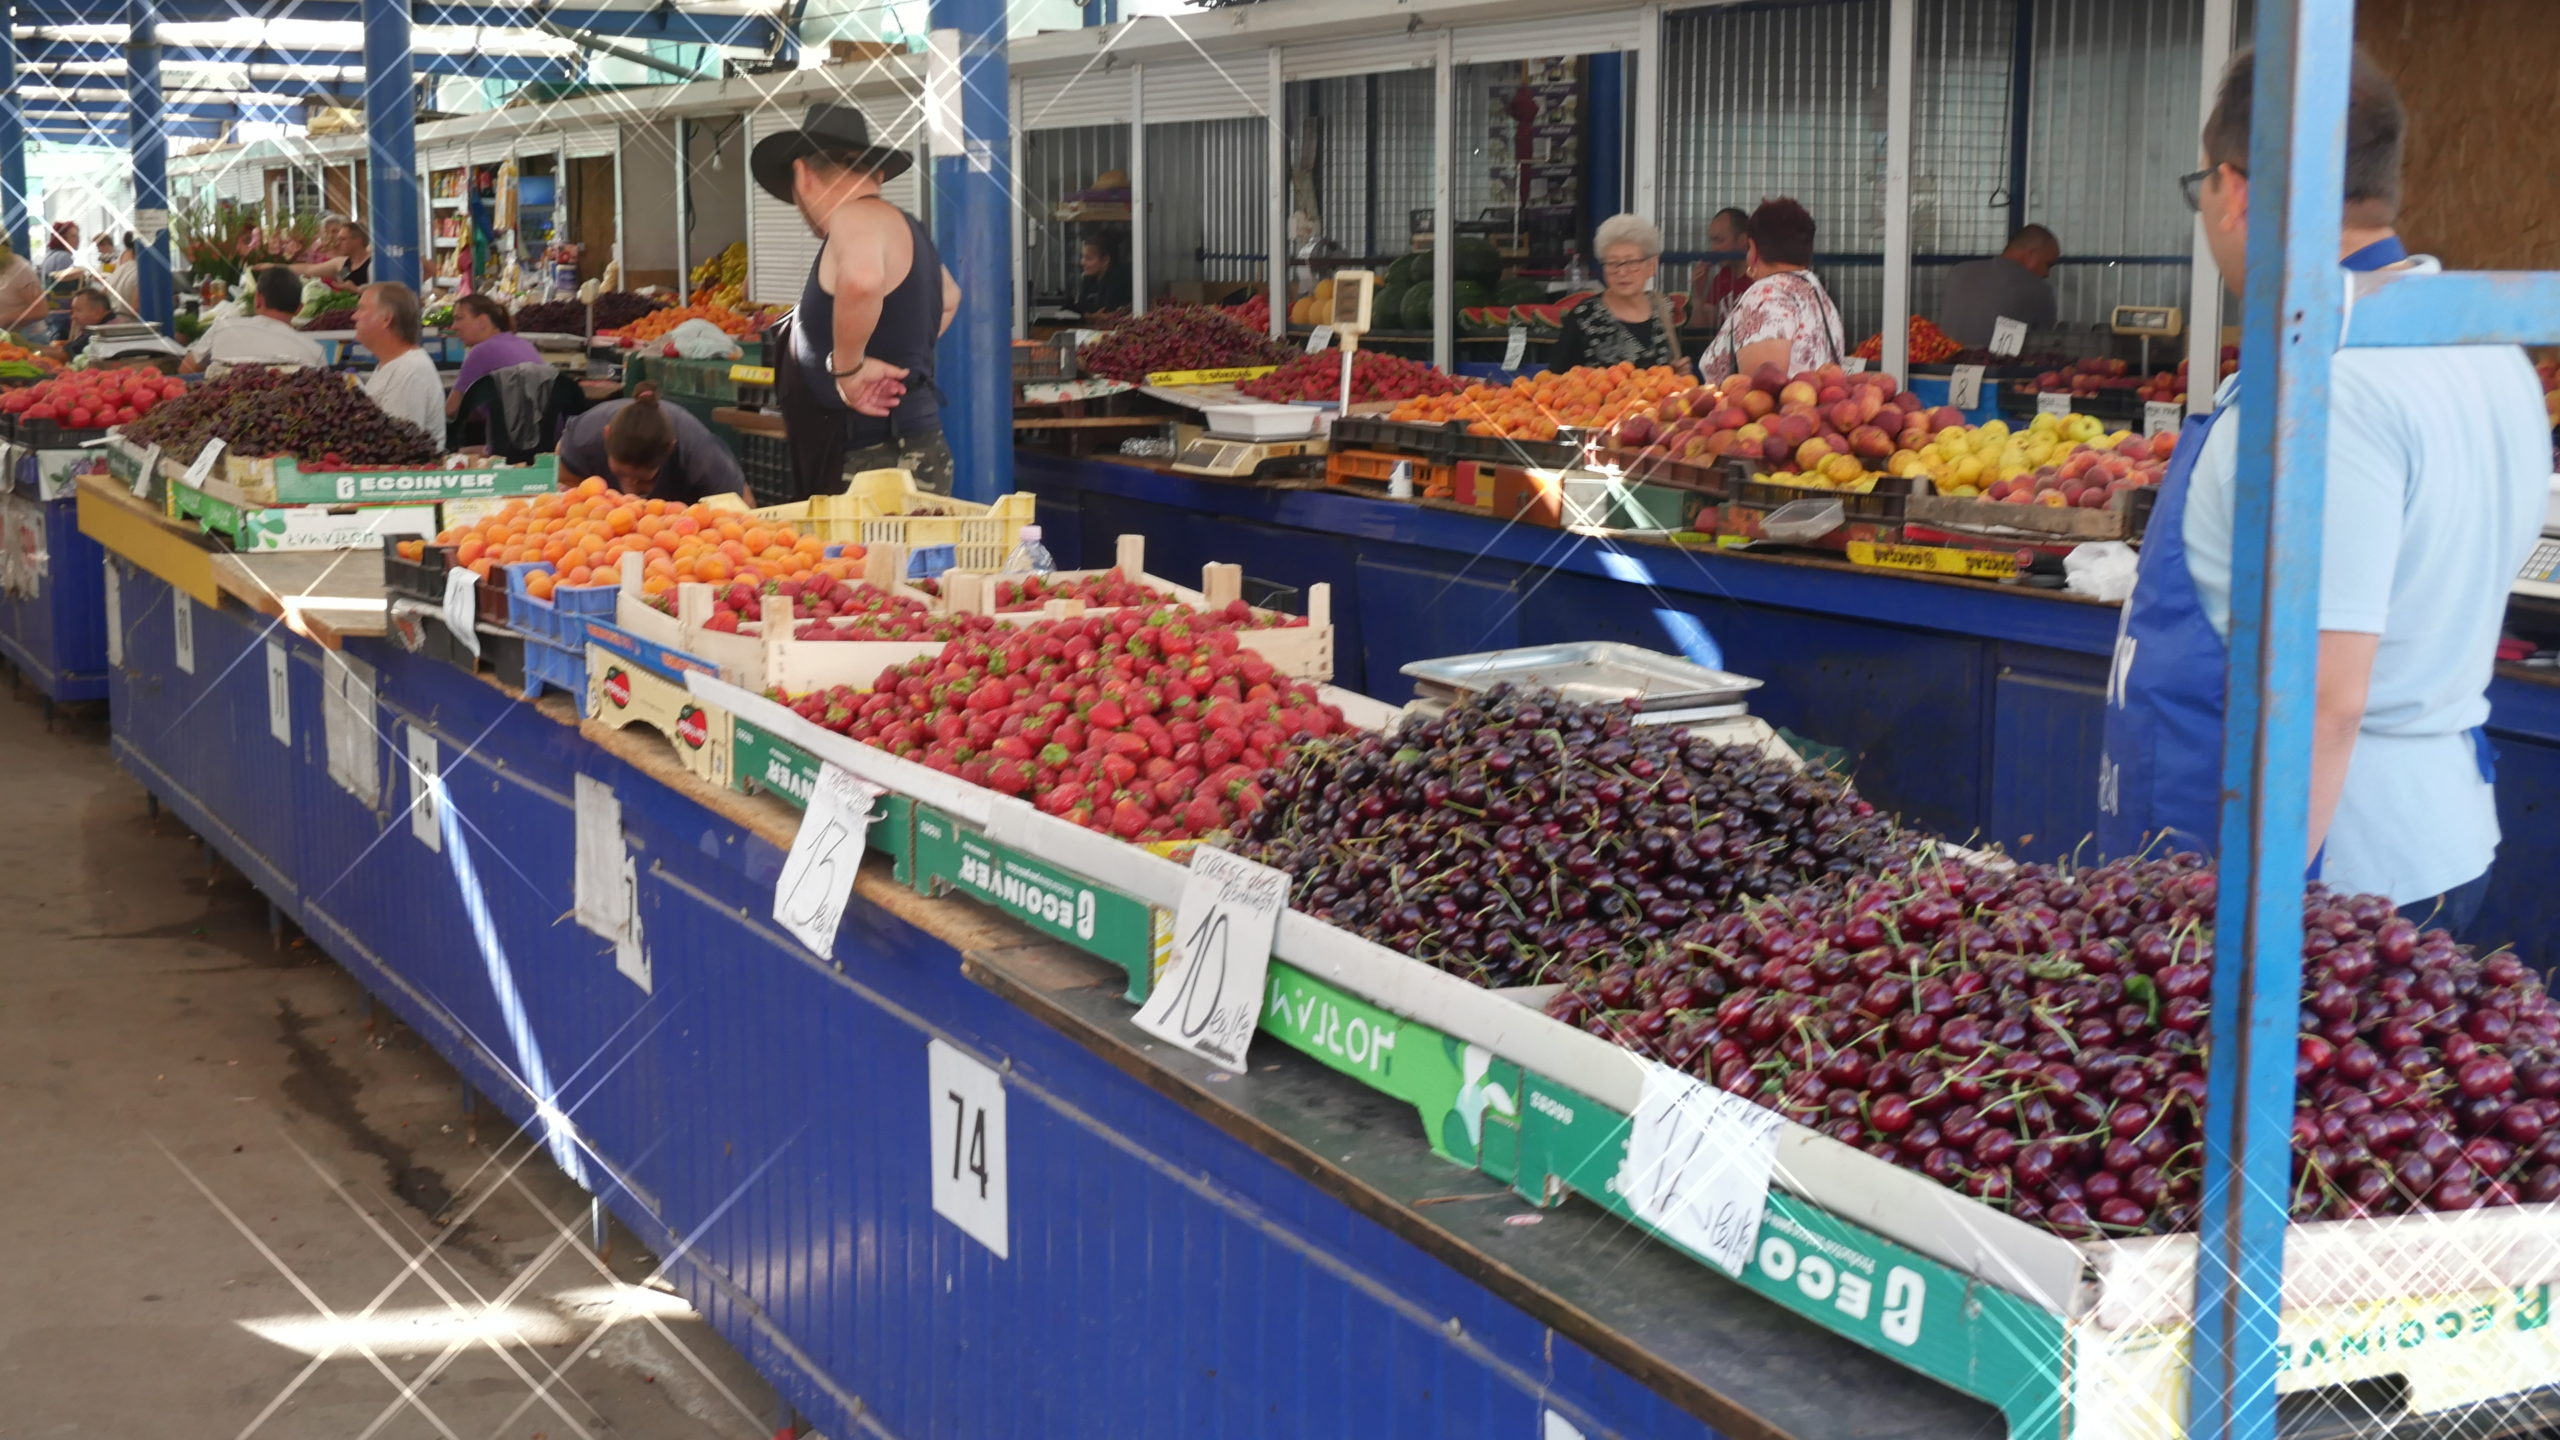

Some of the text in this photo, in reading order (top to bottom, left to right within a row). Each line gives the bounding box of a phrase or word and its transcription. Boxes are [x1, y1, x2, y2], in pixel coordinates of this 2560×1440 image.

[359, 473, 495, 491] ECOINVER
[958, 854, 1074, 930] ECOINVER
[1158, 903, 1229, 1038] 10
[1268, 977, 1395, 1071] HORTAM
[948, 1090, 988, 1200] 74
[2277, 1302, 2495, 1372] ECOINVE
